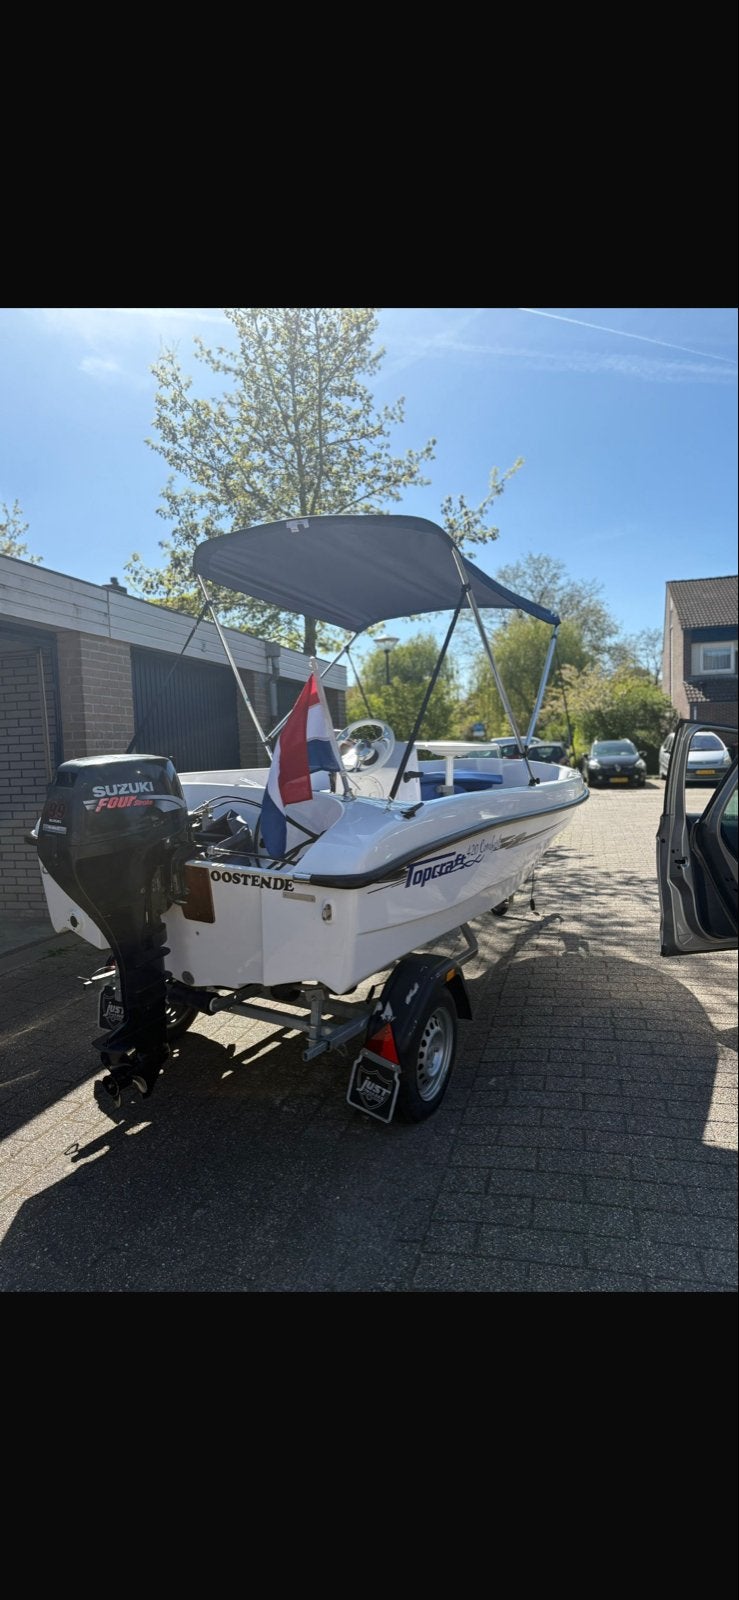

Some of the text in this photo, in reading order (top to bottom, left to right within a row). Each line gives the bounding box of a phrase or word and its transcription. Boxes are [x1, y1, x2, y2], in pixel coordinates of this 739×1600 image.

[92, 781, 154, 798] SUZUKI
[405, 851, 467, 888] Topcraft
[210, 870, 294, 892] OOSTENDE
